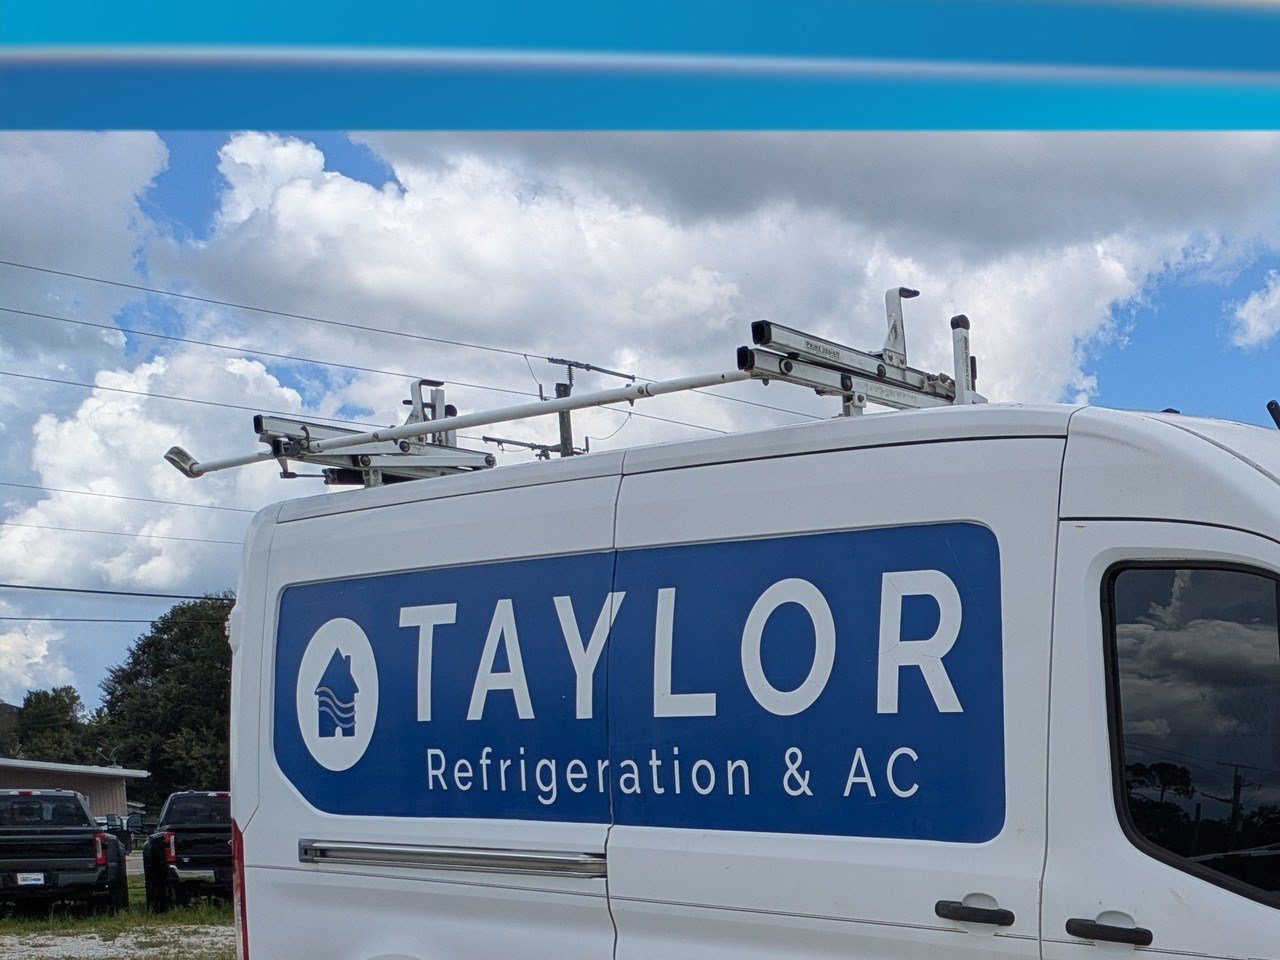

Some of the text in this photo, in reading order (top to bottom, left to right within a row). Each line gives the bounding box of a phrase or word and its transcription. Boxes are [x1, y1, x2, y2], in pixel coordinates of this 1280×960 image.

[398, 569, 965, 723] TAYLOR
[426, 745, 920, 806] Refrigeration & AC
